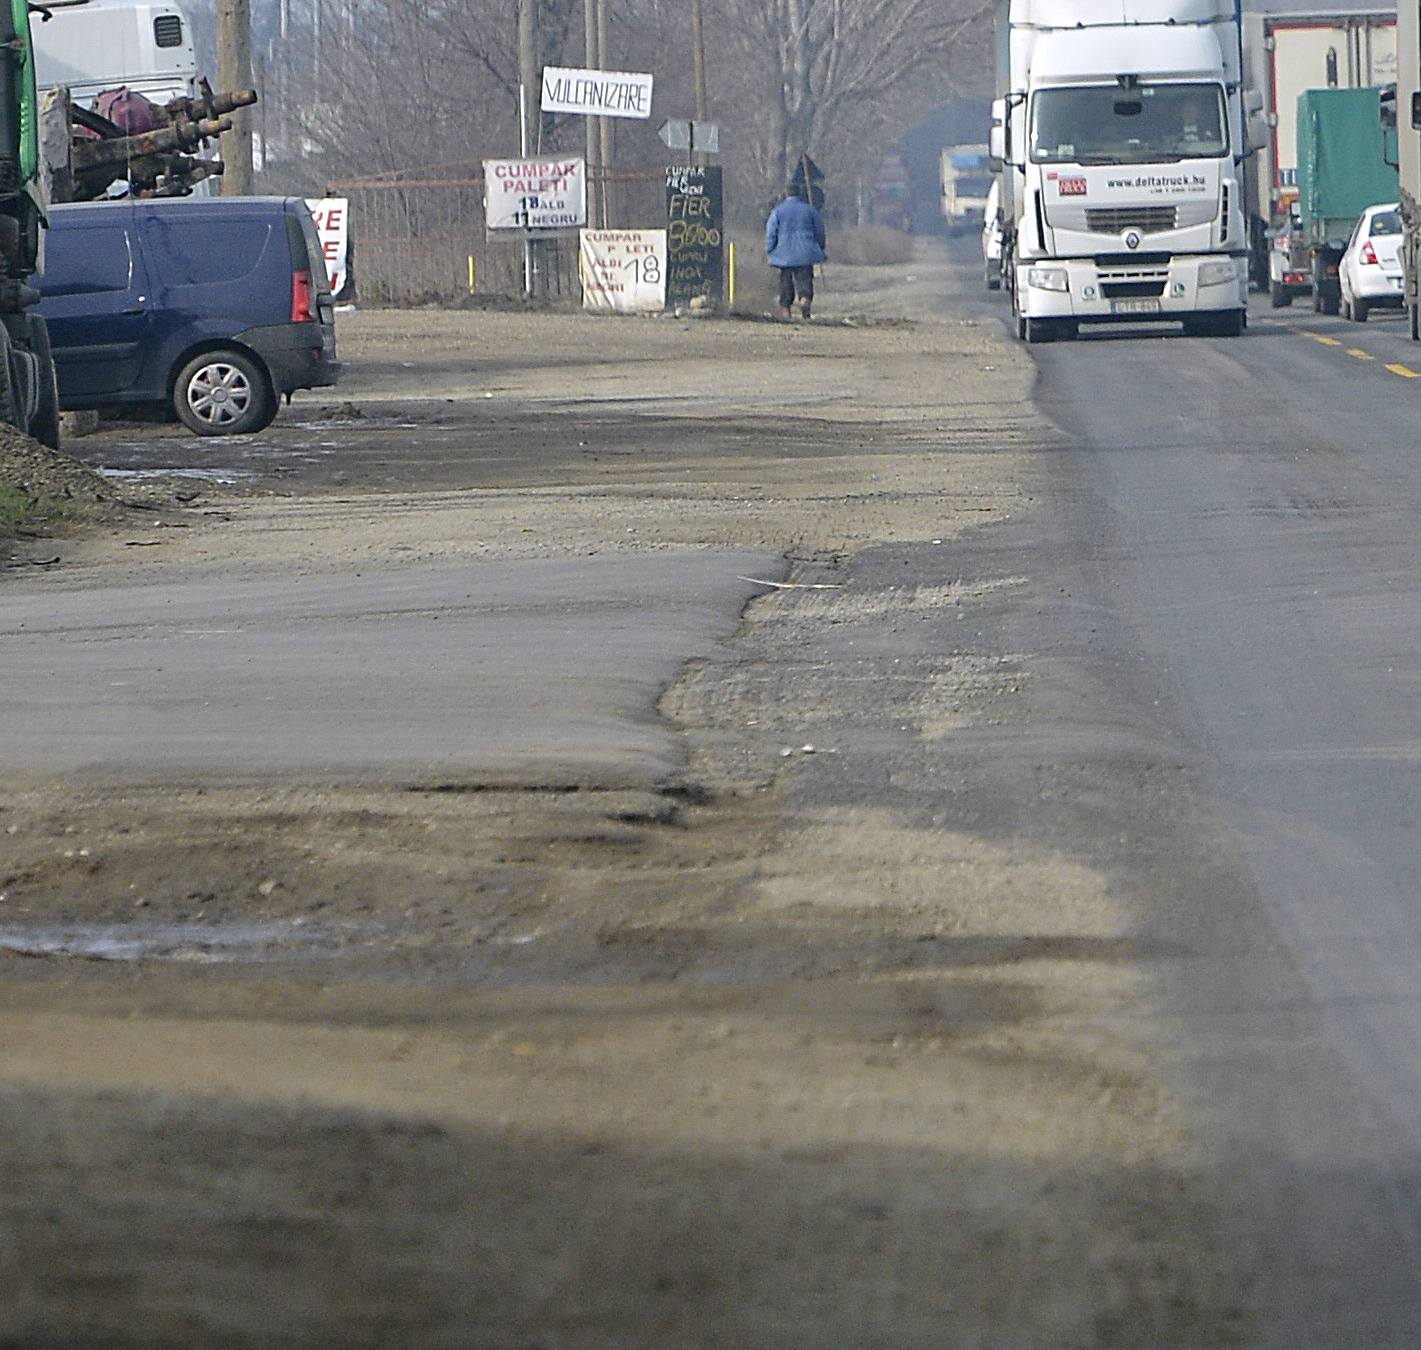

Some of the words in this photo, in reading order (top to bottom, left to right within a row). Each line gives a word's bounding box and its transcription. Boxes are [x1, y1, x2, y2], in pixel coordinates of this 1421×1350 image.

[545, 78, 648, 112] VULCANIZARE
[1107, 175, 1205, 188] www.deltatruck.hu
[670, 194, 710, 218] FIER
[532, 214, 578, 224] NEGRU
[624, 254, 660, 284] 18
